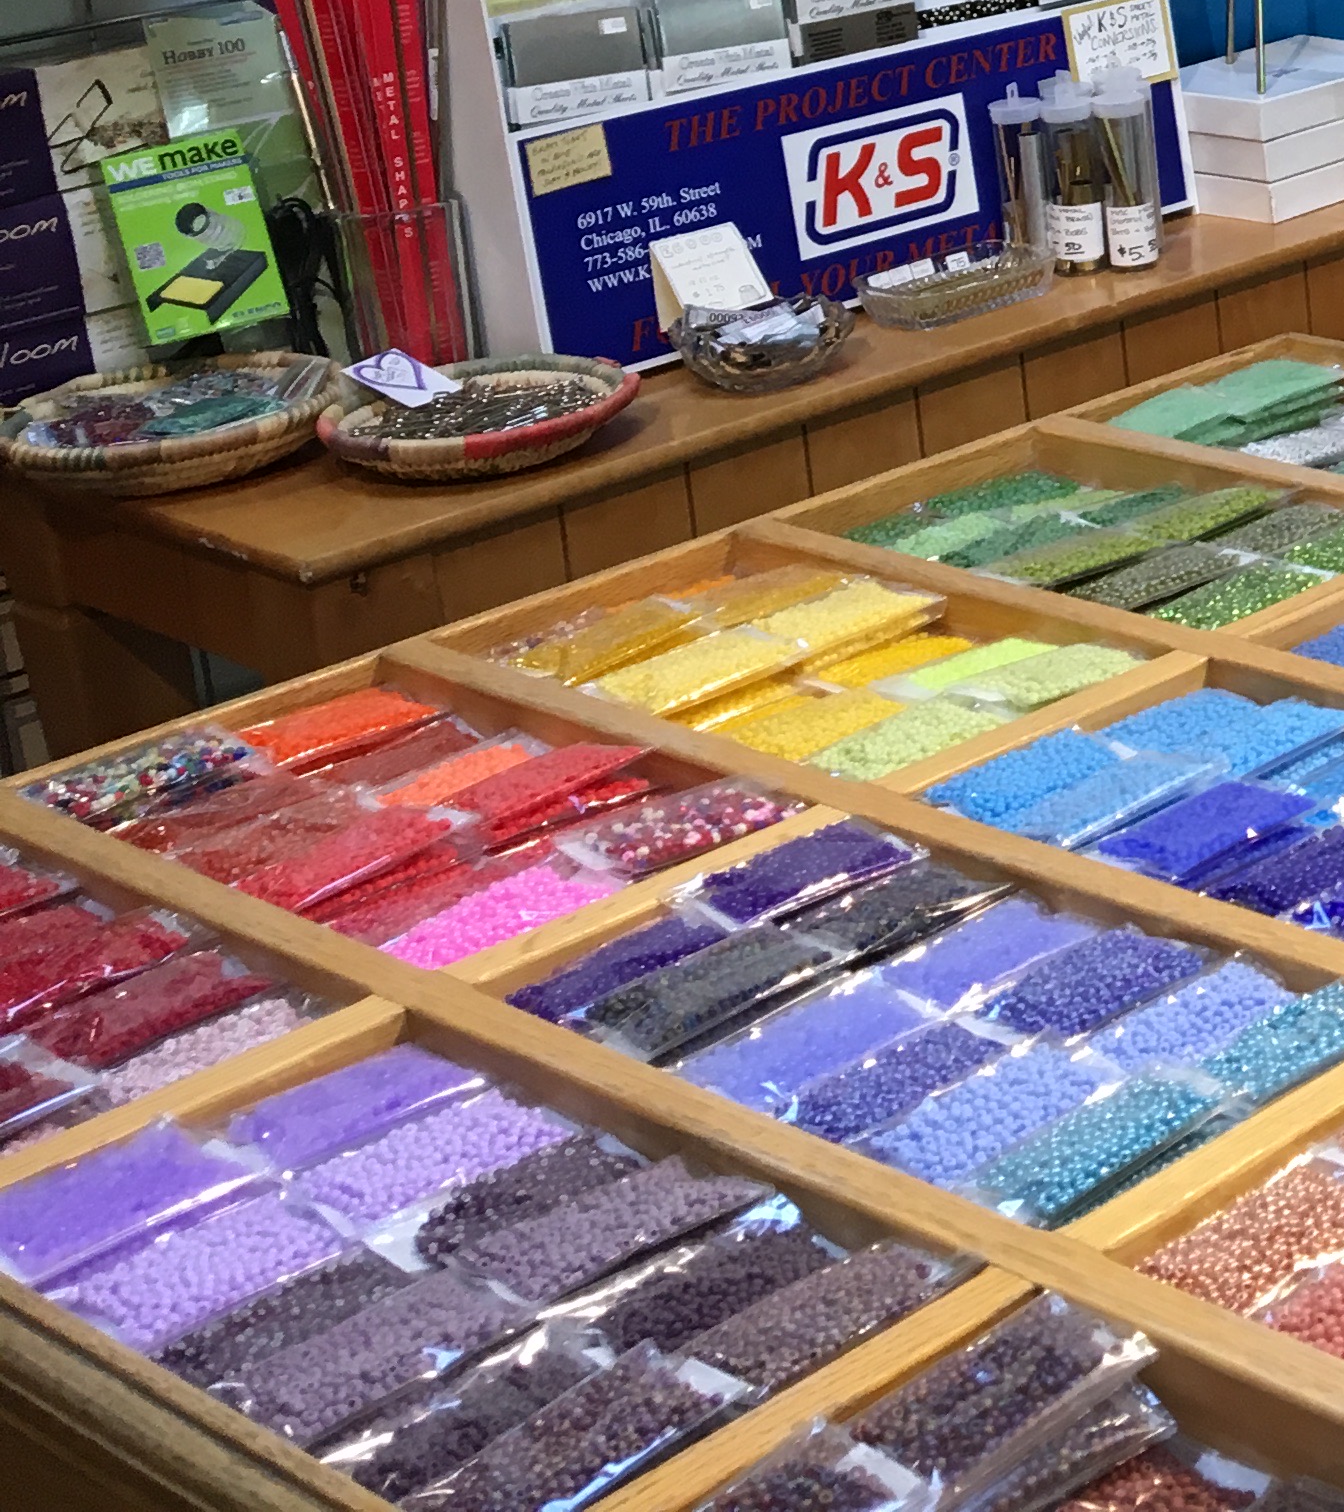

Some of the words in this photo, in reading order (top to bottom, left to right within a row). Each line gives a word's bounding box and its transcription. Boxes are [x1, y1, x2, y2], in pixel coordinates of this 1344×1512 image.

[217, 38, 246, 56] 100
[382, 71, 400, 140] METAL
[664, 105, 741, 152] THE
[754, 63, 916, 132] PROJECT
[924, 33, 1057, 88] CENTER
[107, 157, 157, 182] WE
[157, 139, 239, 171] make
[822, 125, 943, 229] K&S
[577, 206, 614, 230] 6917
[616, 201, 638, 220] W.
[640, 192, 678, 213] 59th.
[680, 181, 722, 203] Street
[580, 223, 647, 251] Chicago,
[648, 216, 671, 234] IL.
[673, 202, 718, 227] 60638
